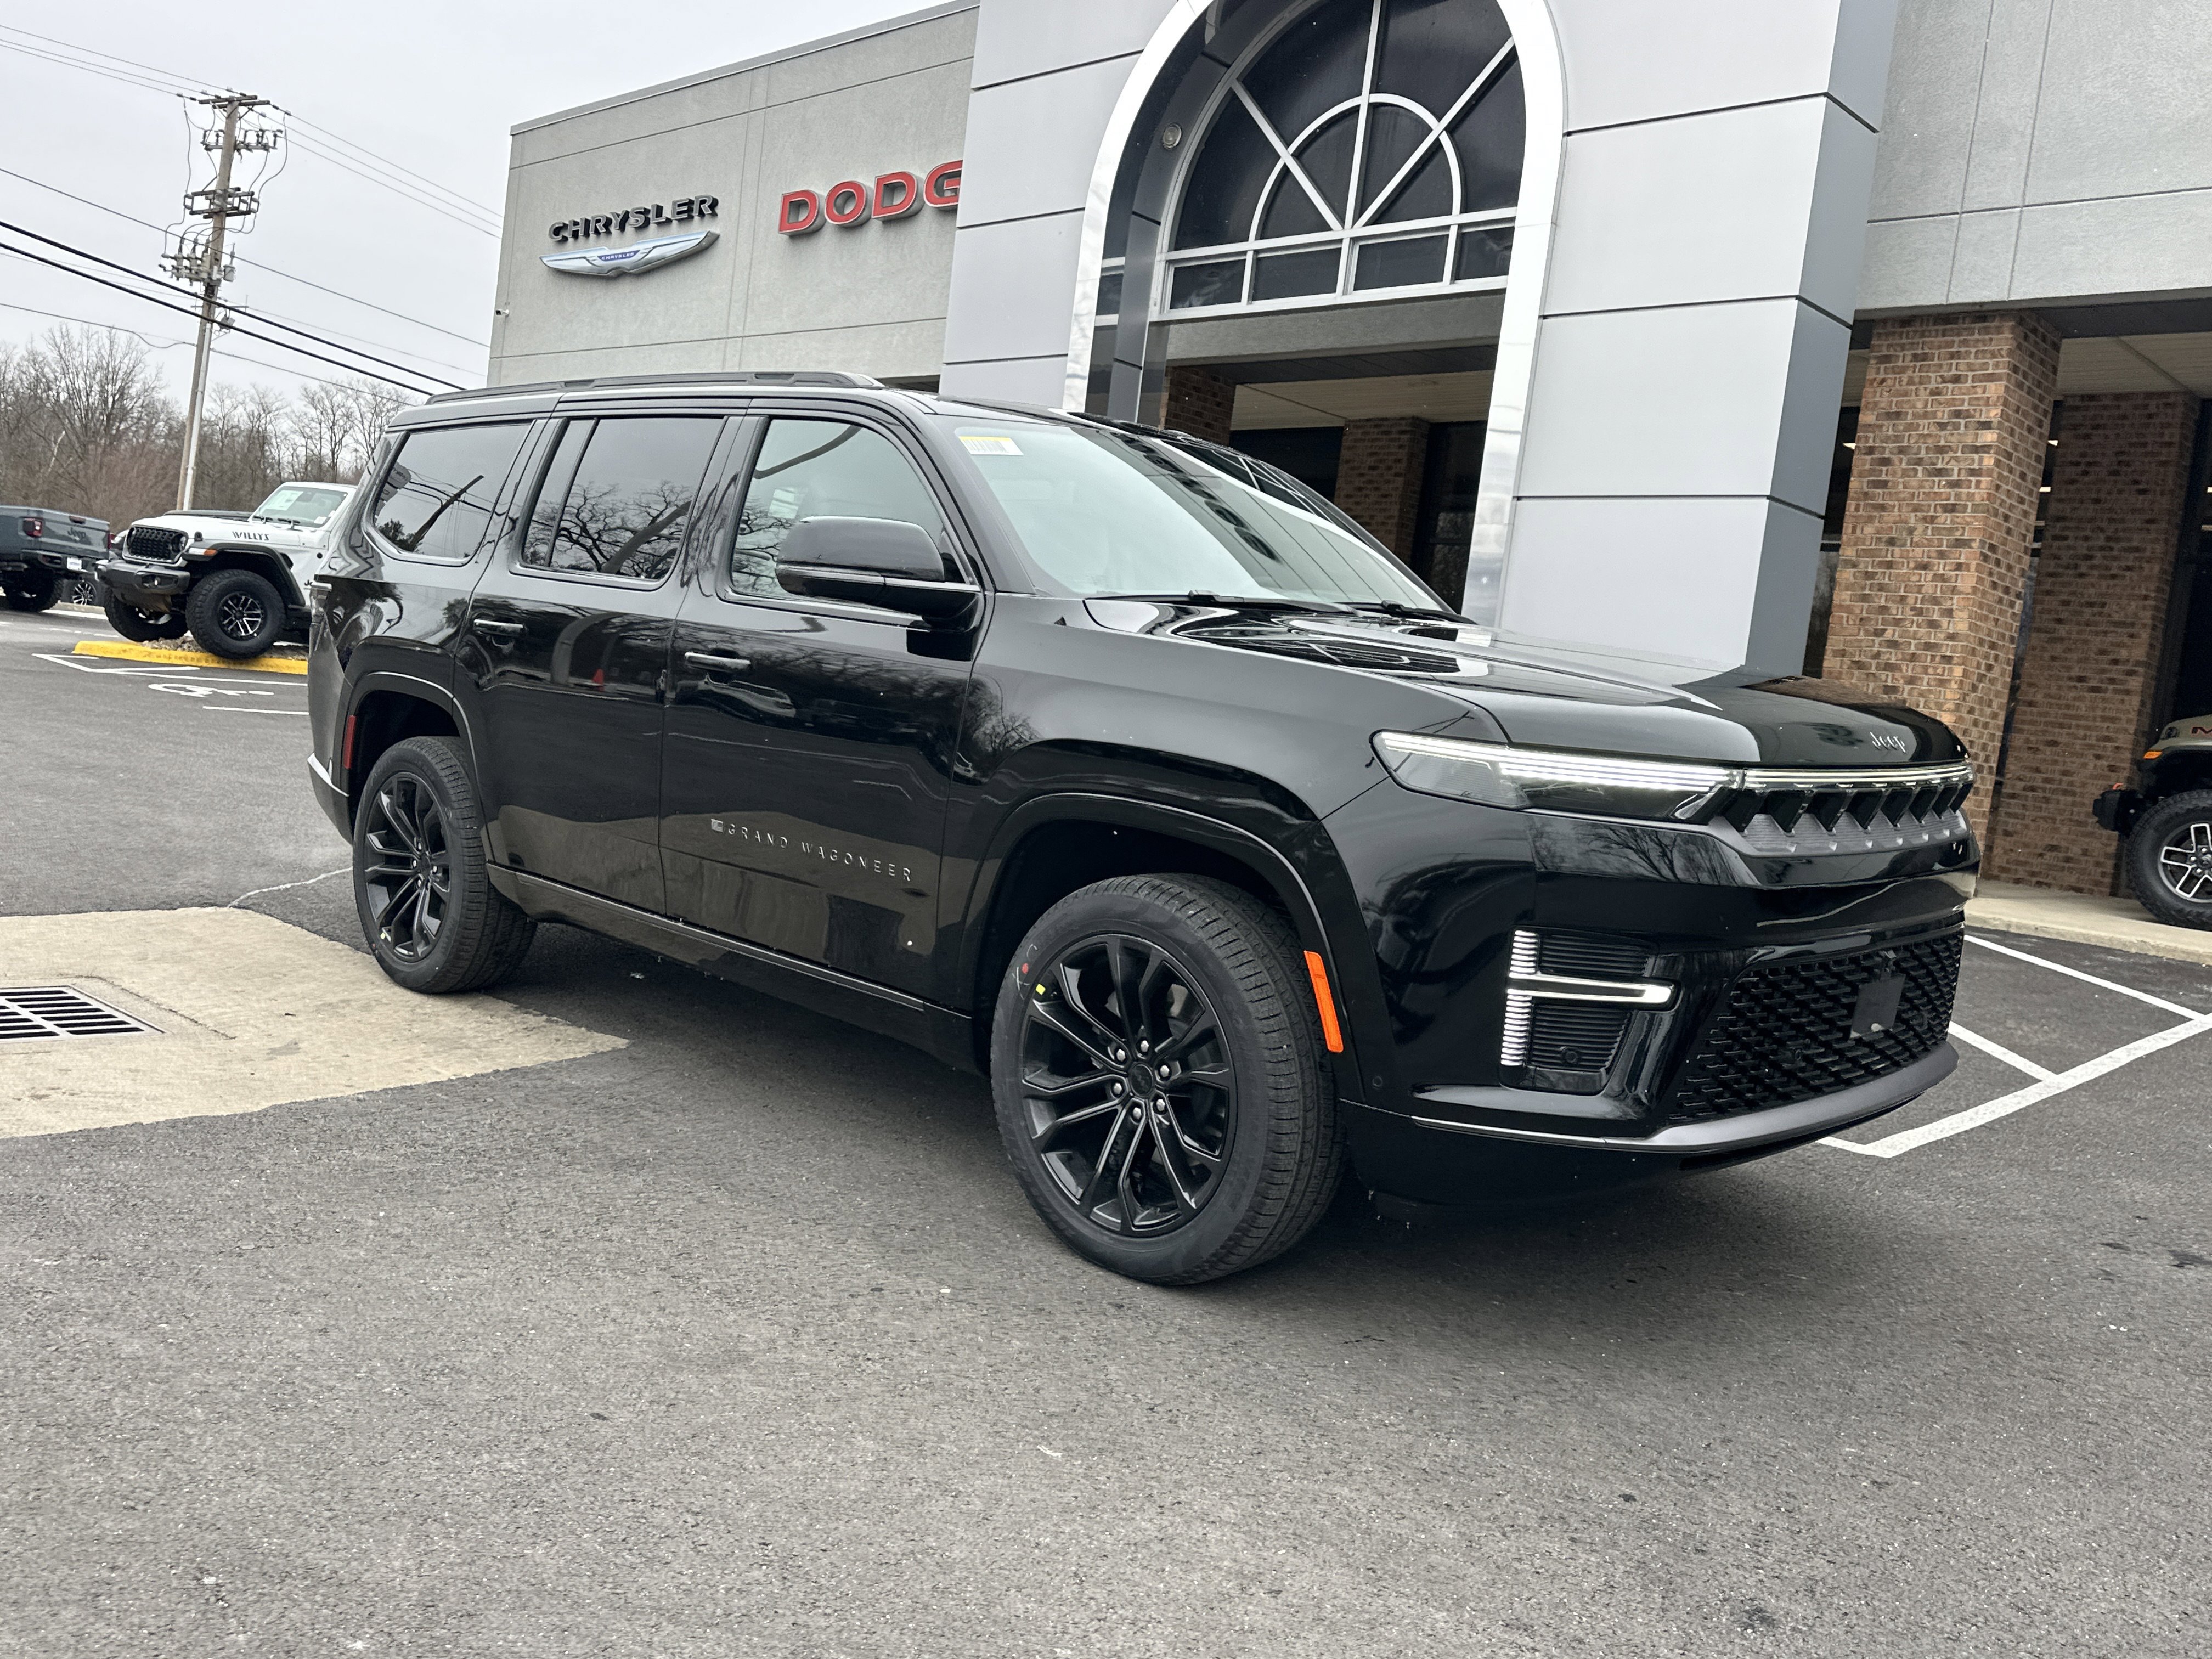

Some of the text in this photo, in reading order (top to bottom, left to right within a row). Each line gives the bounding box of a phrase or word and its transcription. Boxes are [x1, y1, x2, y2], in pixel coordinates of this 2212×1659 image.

[549, 195, 719, 242] CHRYSLER
[232, 531, 269, 541] WILLYS
[1870, 732, 1906, 753] Jeep
[727, 823, 911, 882] GRAND WAGONEER
